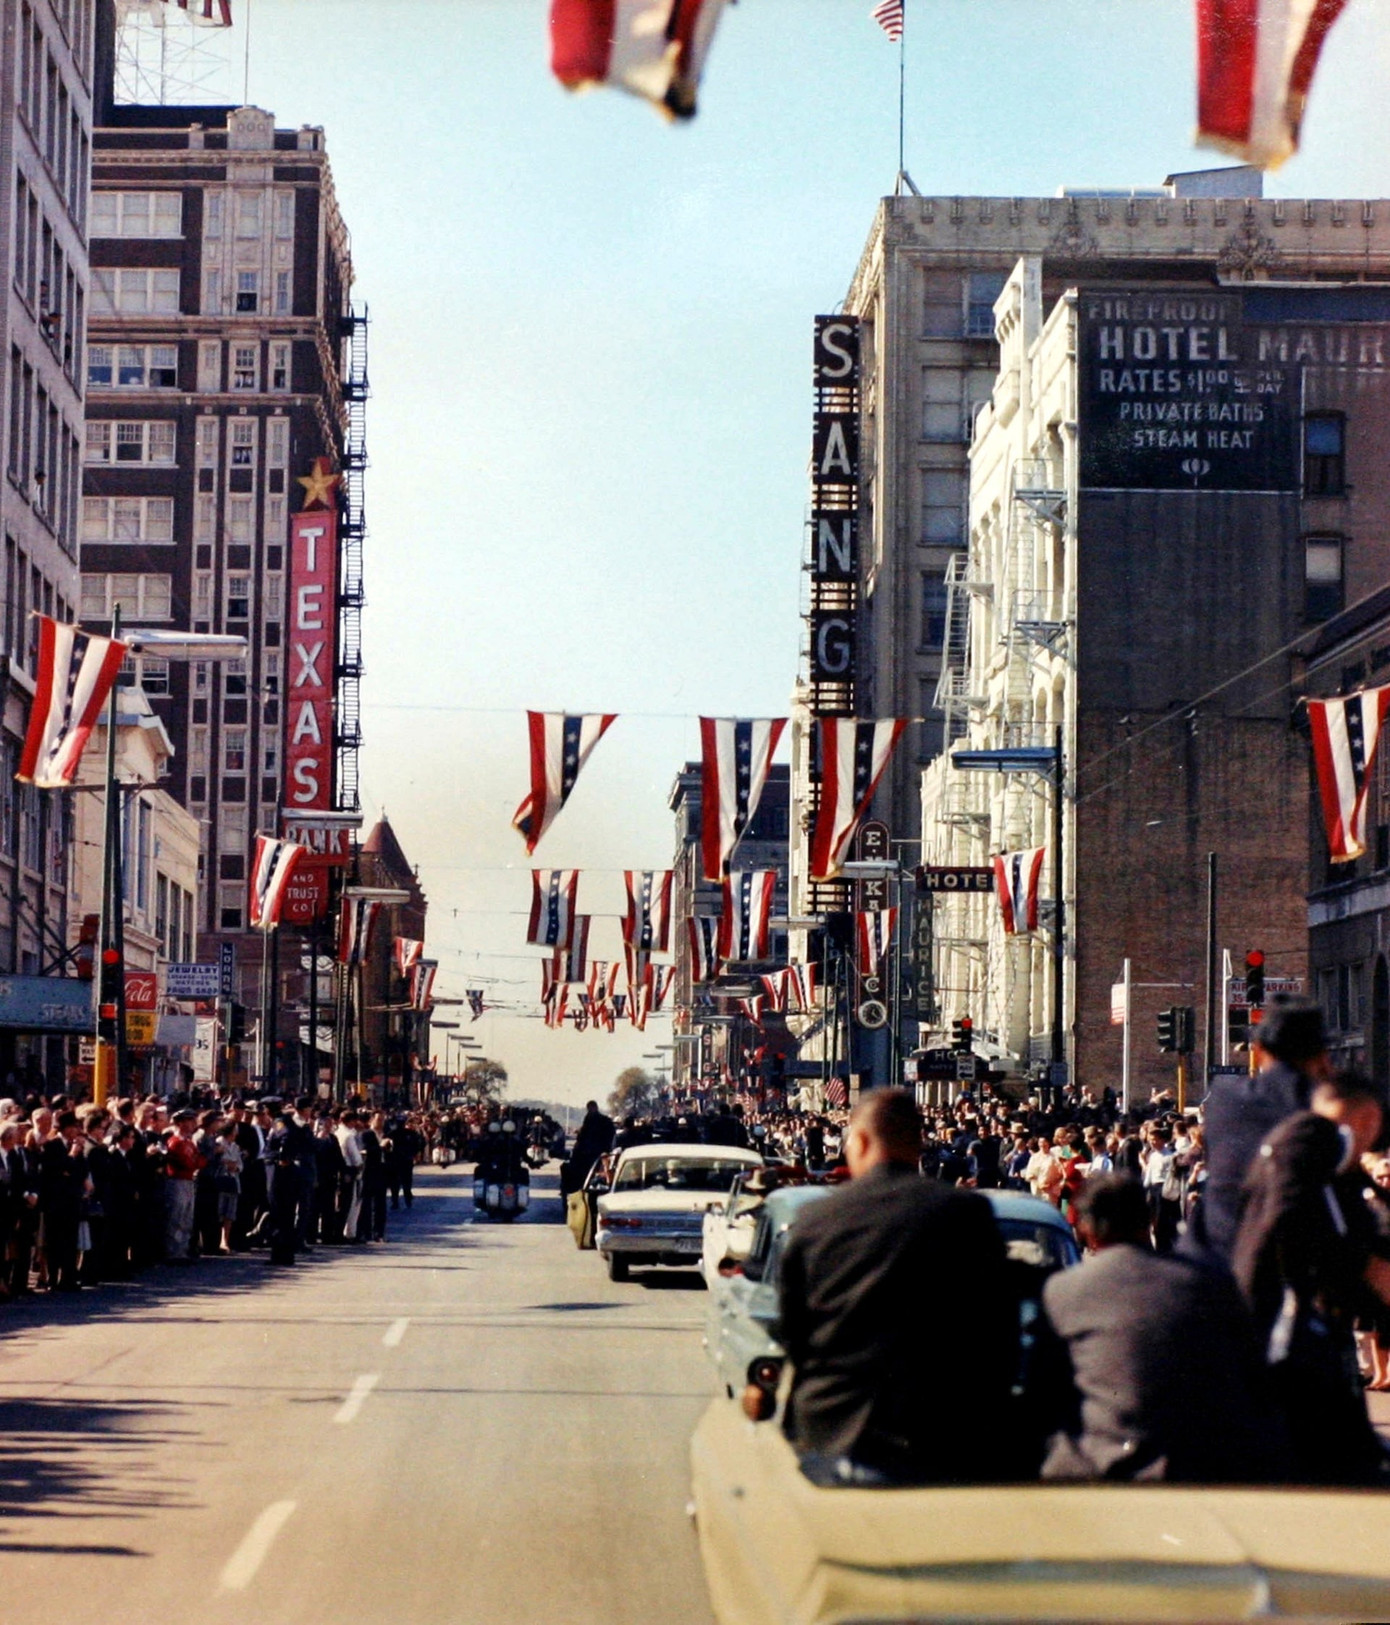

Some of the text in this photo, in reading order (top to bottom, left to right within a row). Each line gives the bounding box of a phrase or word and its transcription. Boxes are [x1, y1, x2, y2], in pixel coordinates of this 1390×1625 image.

[1100, 326, 1385, 363] HOTEL MAUR
[1101, 370, 1182, 393] RATES
[1256, 383, 1283, 394] DAY
[1120, 402, 1265, 422] PRIVATE BATHS
[1134, 430, 1254, 449] STEAM HEAT
[817, 323, 853, 675] SANG
[292, 527, 324, 804] TEXAS
[286, 825, 342, 855] BANK
[293, 874, 314, 883] AND
[926, 873, 988, 889] HOTE
[287, 888, 319, 899] TRUST
[918, 899, 930, 1011] MAURICE
[168, 966, 218, 974] JEWELRY
[1265, 983, 1300, 992] ARKING
